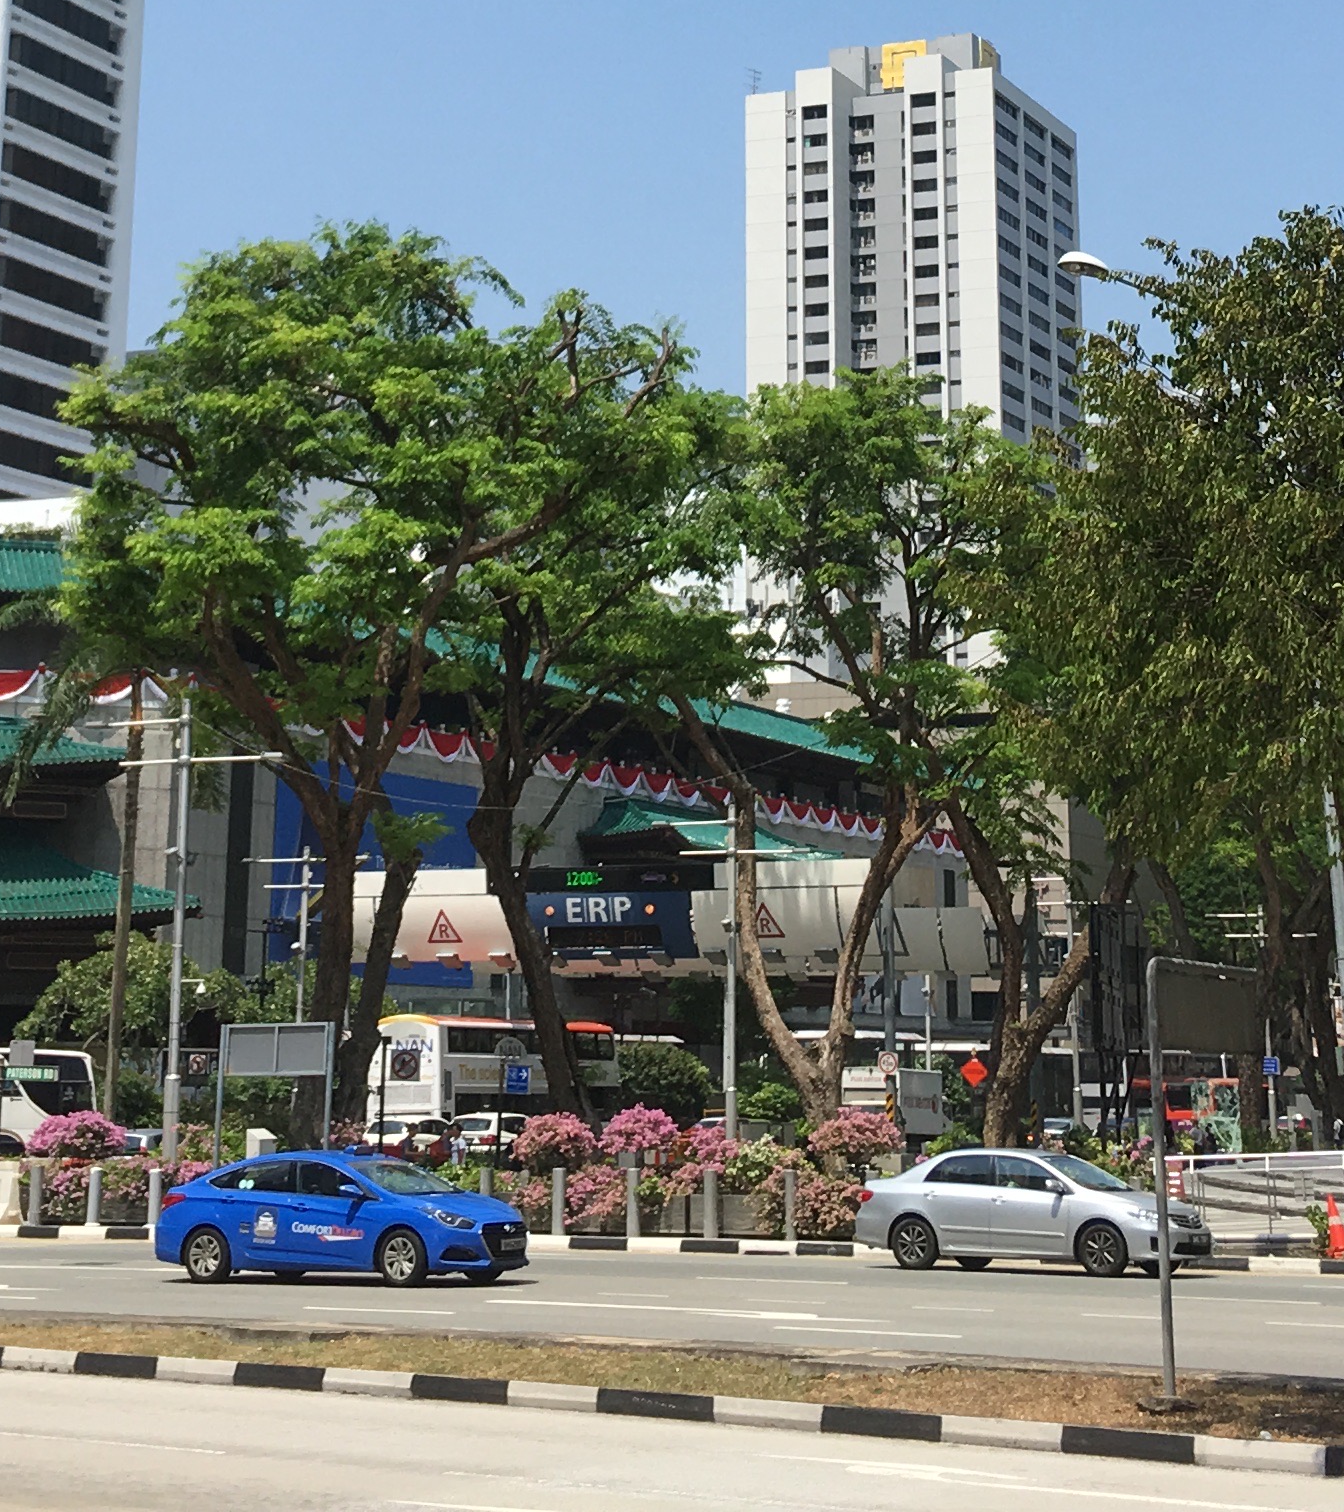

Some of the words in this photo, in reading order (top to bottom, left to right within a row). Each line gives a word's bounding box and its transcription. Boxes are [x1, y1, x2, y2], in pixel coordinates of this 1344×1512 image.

[439, 924, 450, 938] R
[760, 918, 772, 933] R
[396, 1039, 433, 1052] NAN
[6, 1067, 42, 1079] PATERSON
[44, 1068, 54, 1079] RD
[460, 1064, 477, 1080] The
